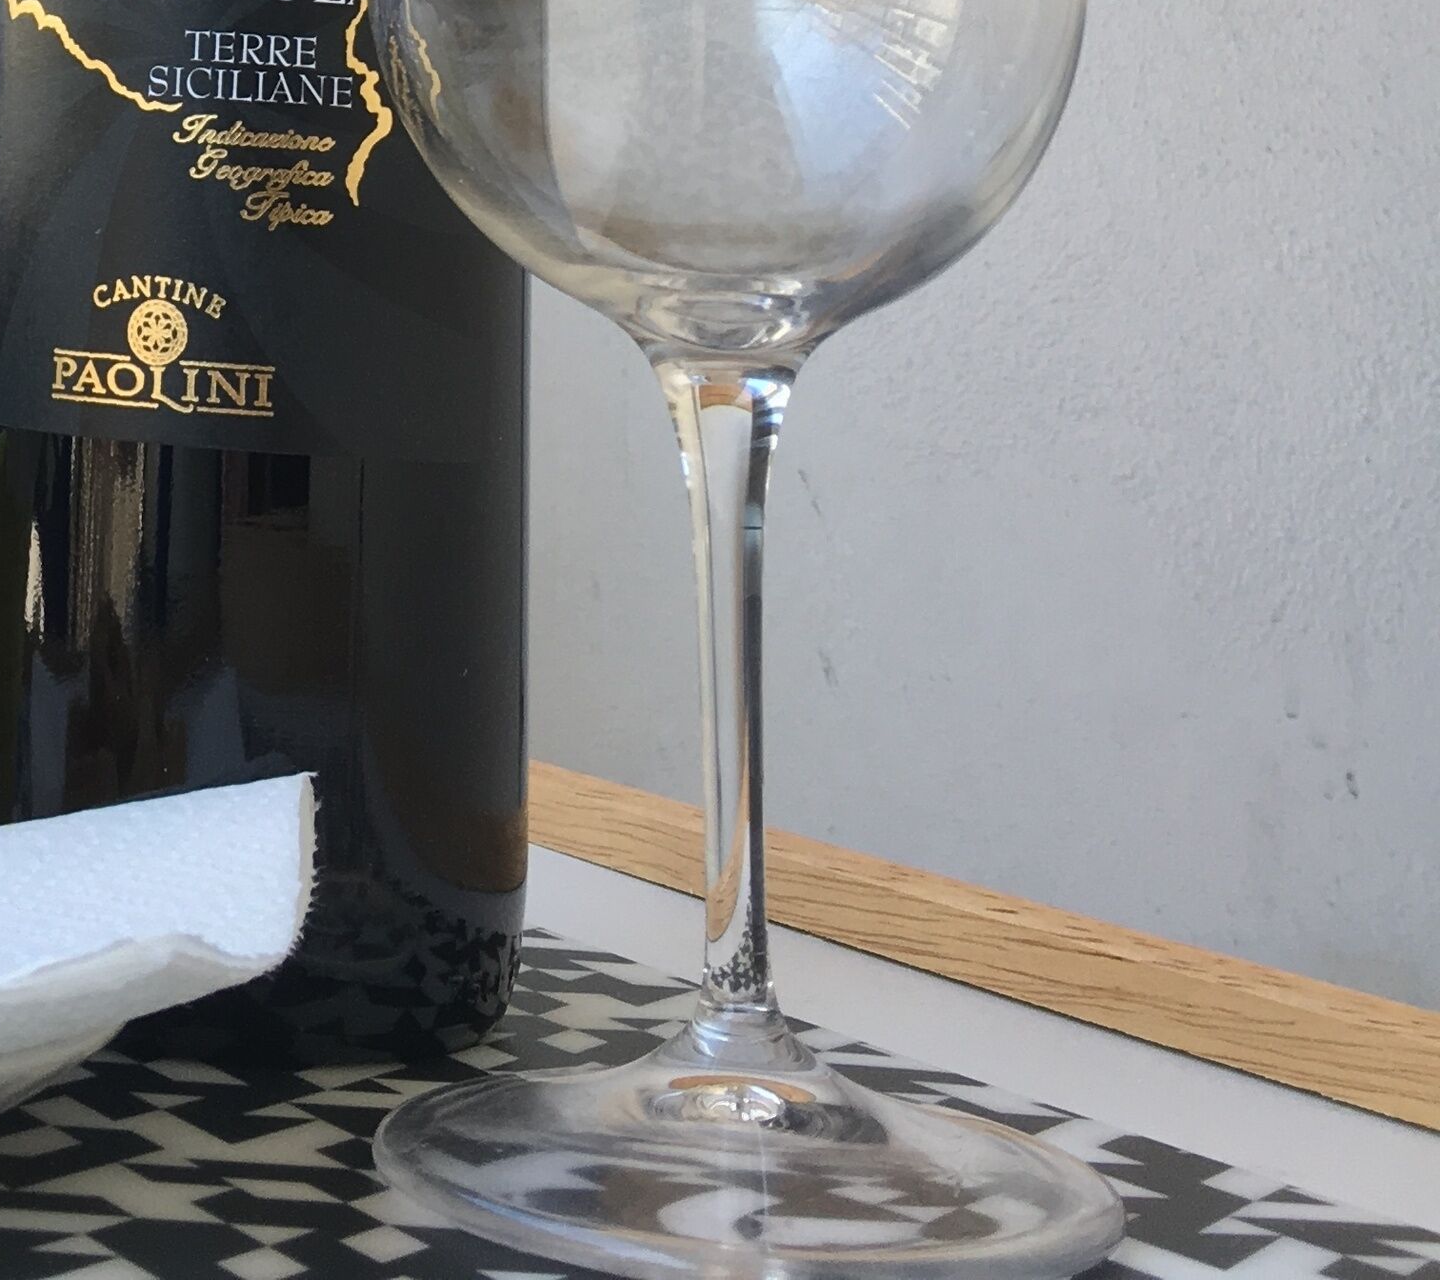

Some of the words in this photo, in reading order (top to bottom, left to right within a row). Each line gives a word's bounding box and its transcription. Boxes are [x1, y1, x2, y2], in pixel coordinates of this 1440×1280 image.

[184, 30, 318, 68] TERRE
[148, 67, 353, 109] SICILIANE
[173, 114, 336, 153] Indicazione
[189, 144, 335, 190] Geografica
[240, 189, 334, 231] Tipica
[93, 275, 227, 319] CANTINE
[52, 357, 274, 414] PAOLINI
